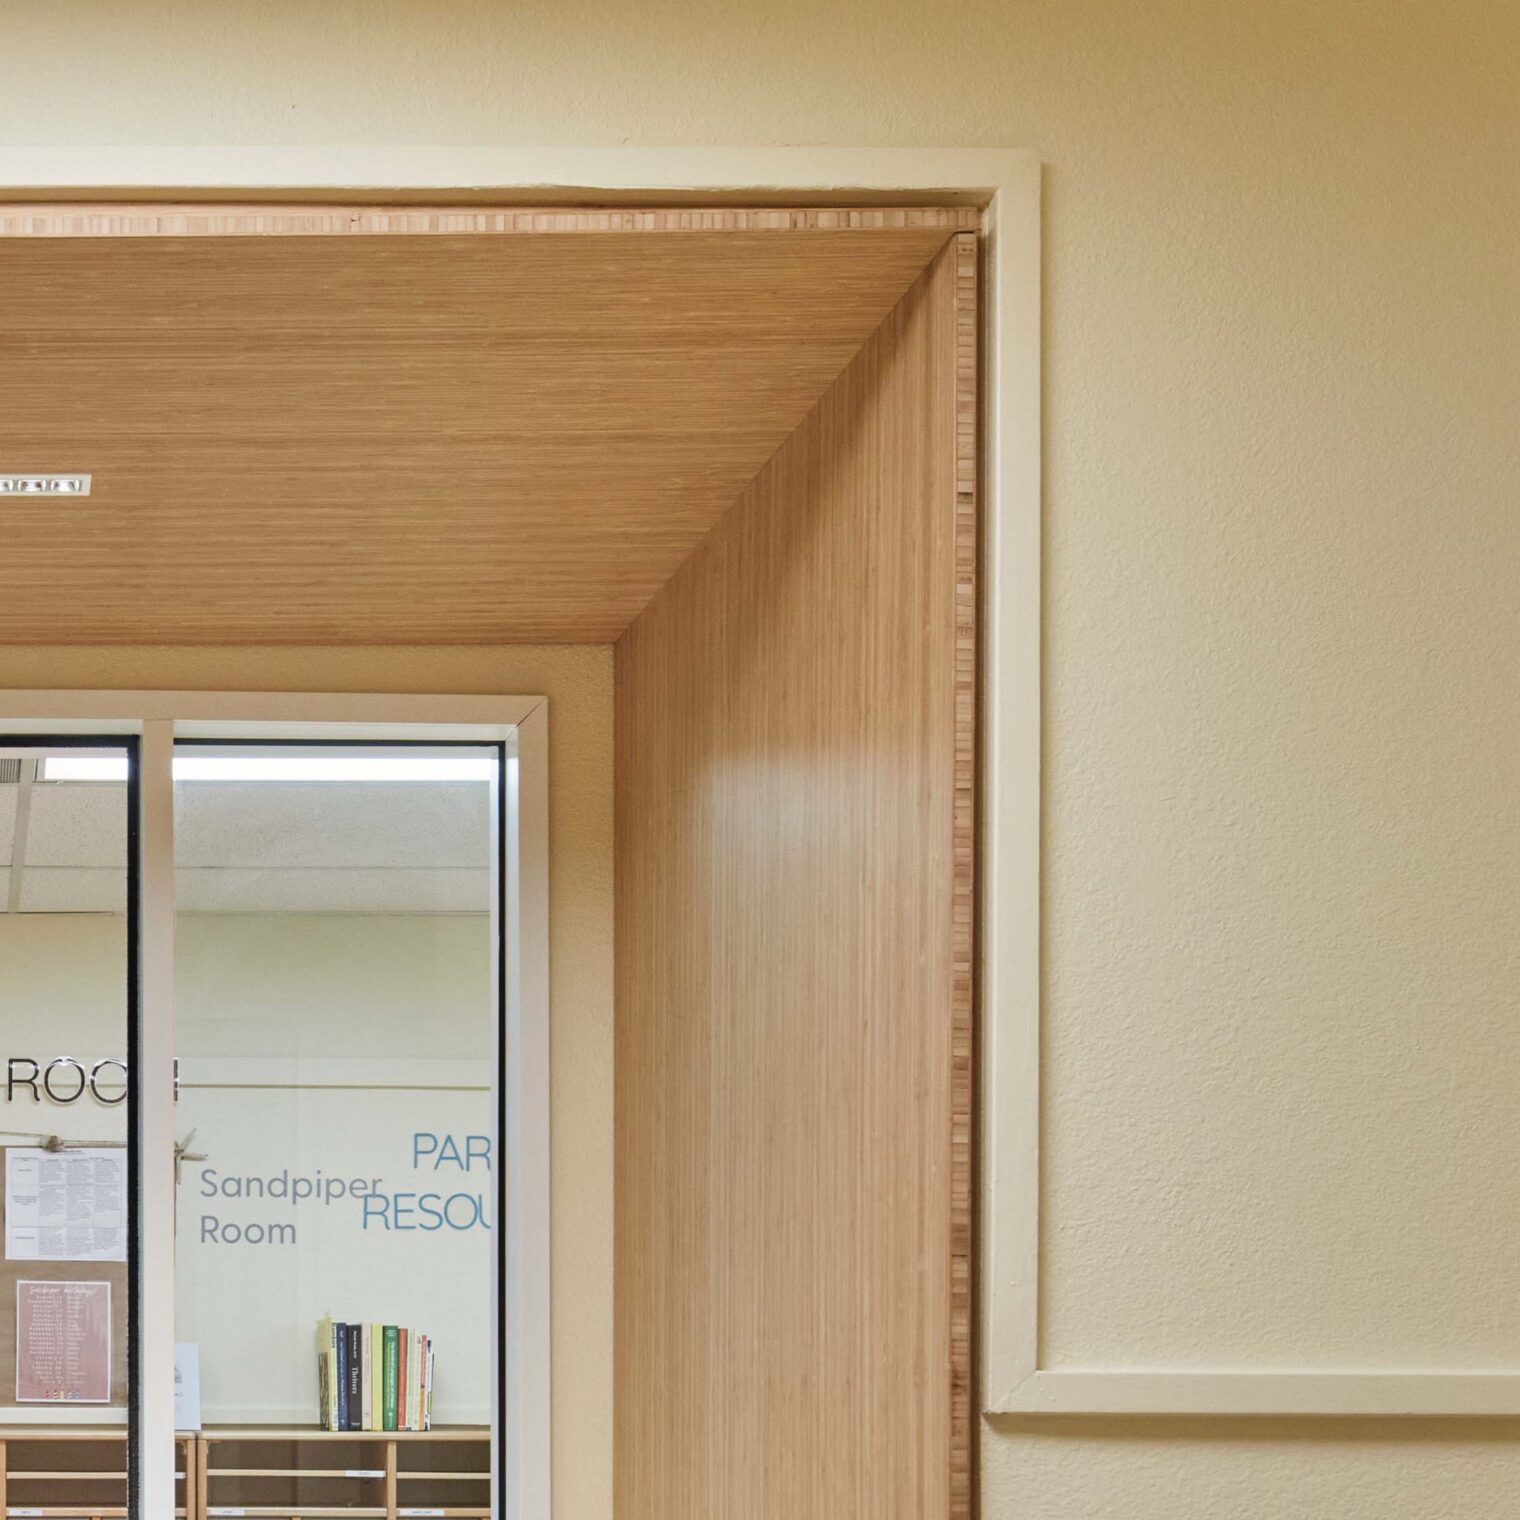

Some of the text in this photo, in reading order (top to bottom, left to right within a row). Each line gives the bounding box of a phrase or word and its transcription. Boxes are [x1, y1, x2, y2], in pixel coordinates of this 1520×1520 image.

[7, 1057, 180, 1105] ROO
[200, 1168, 383, 1205] Sandpiper
[200, 1215, 297, 1245] Room
